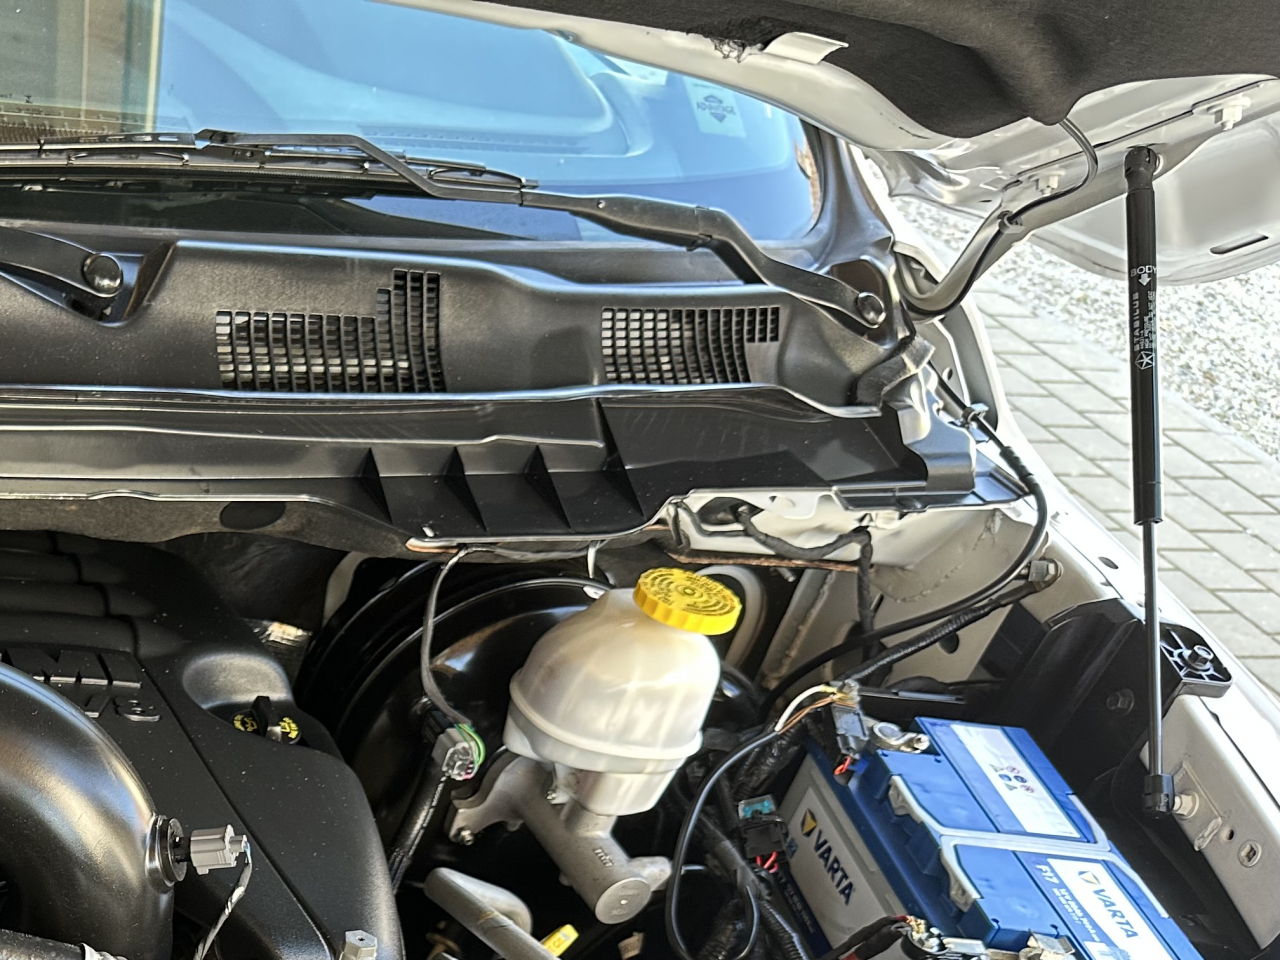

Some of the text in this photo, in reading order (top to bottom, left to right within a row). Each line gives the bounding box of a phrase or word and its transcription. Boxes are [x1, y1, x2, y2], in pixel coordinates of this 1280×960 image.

[1131, 265, 1156, 277] BODY
[1132, 292, 1140, 352] STABILUS
[814, 828, 853, 906] VARTA
[1035, 864, 1060, 884] F17
[1092, 889, 1139, 938] VARTA
